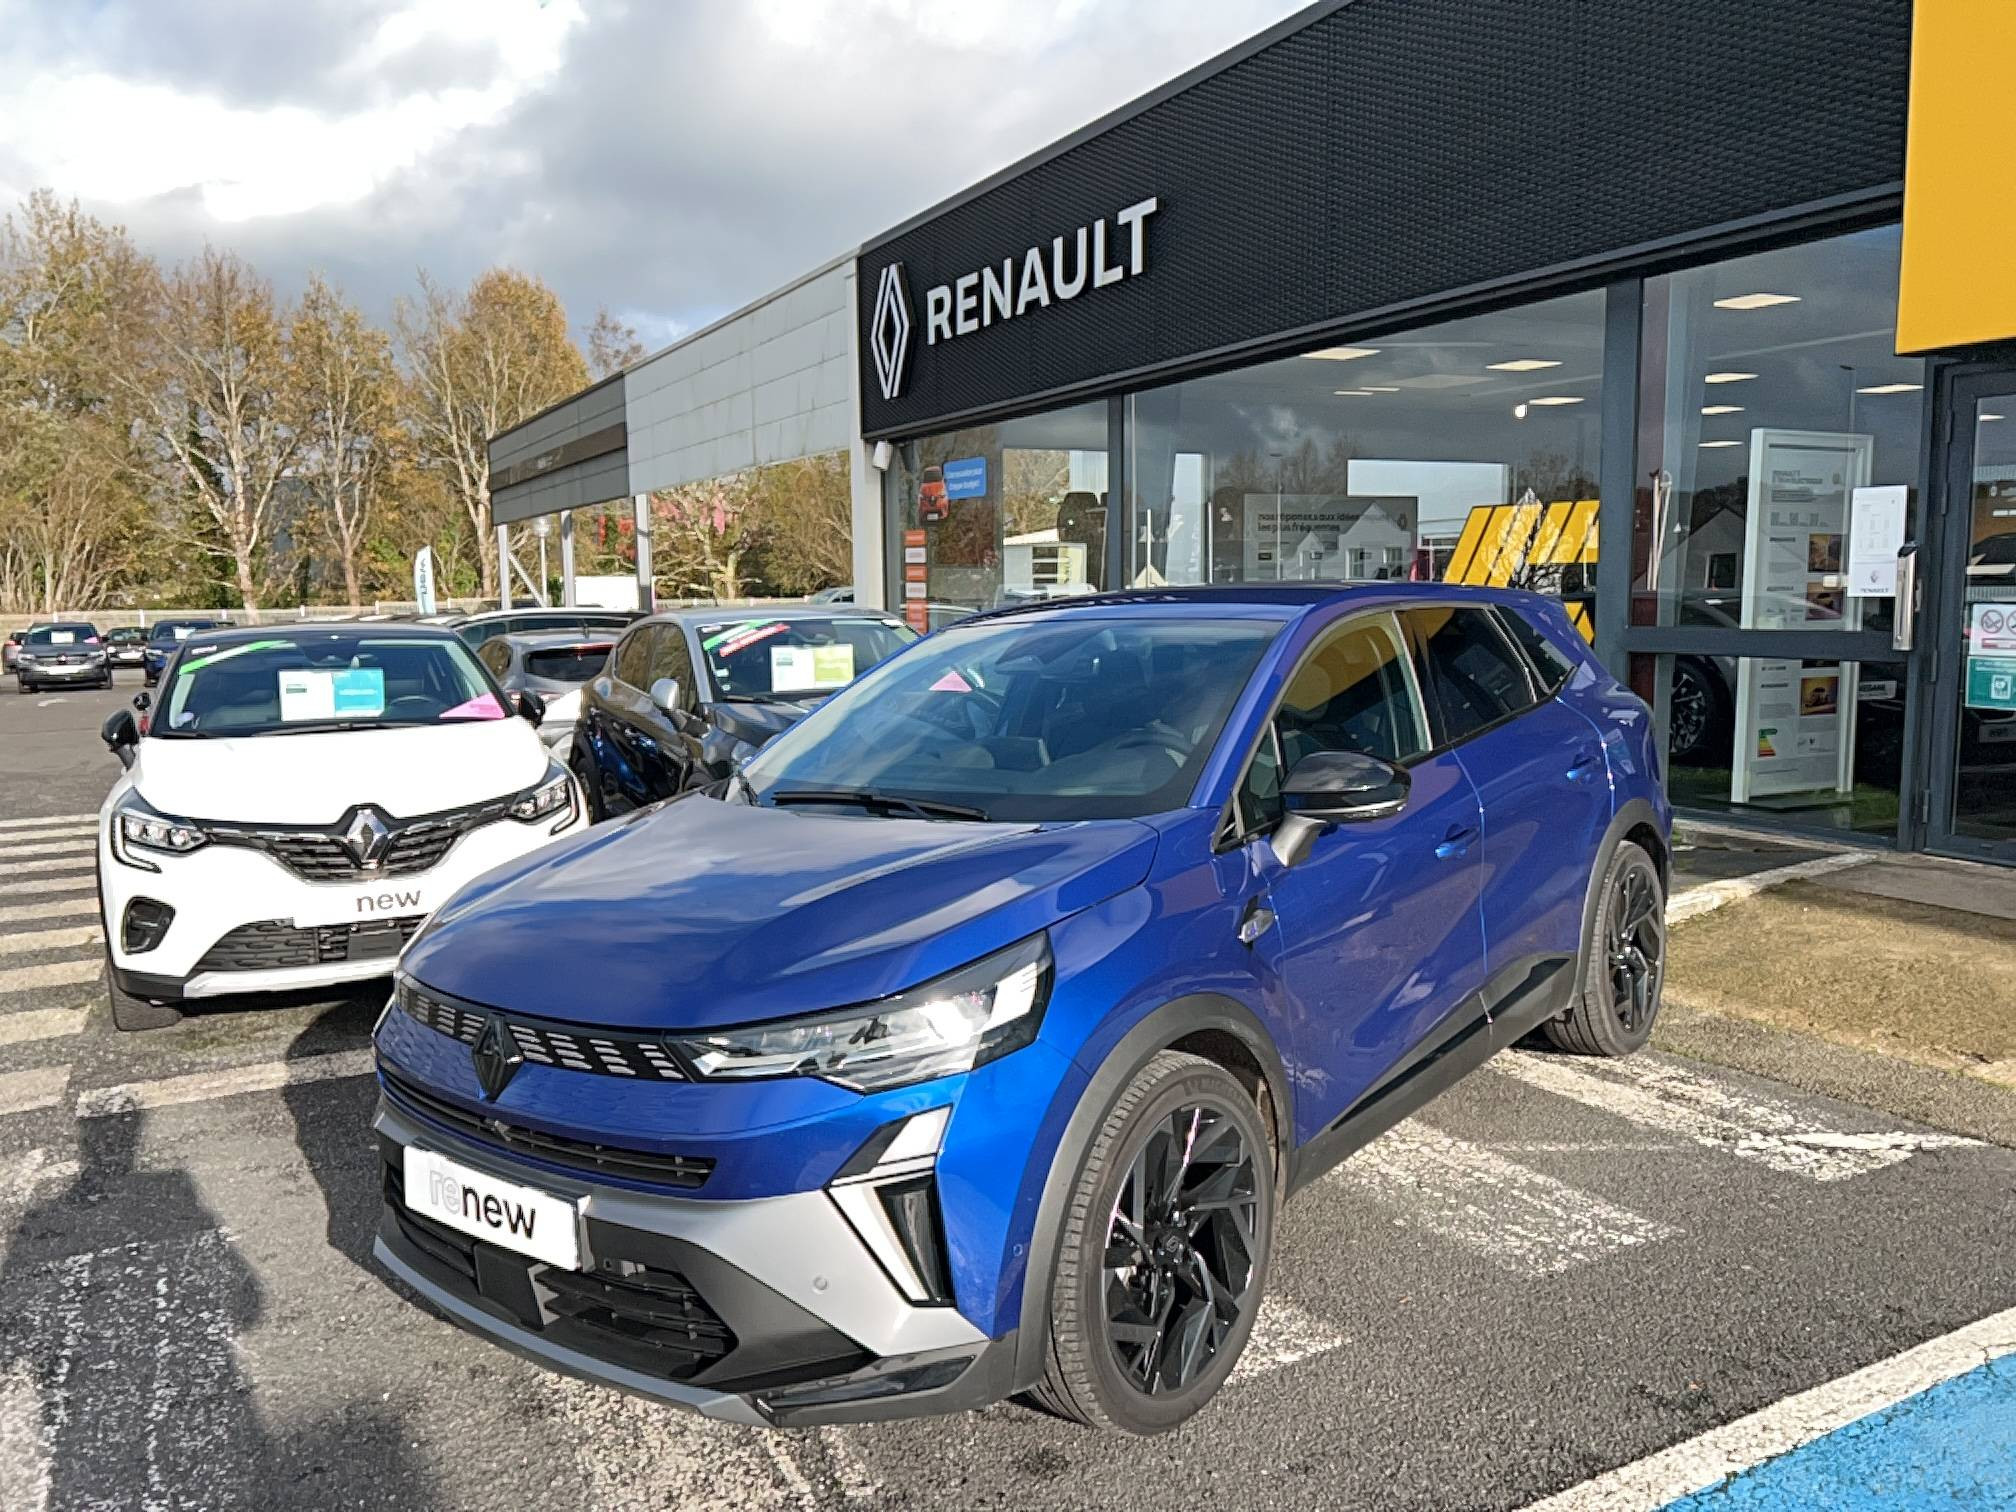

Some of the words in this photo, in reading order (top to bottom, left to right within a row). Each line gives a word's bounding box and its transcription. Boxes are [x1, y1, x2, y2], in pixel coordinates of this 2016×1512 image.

[926, 196, 1158, 345] RENAULT
[356, 890, 421, 912] new
[429, 1168, 536, 1239] renew
